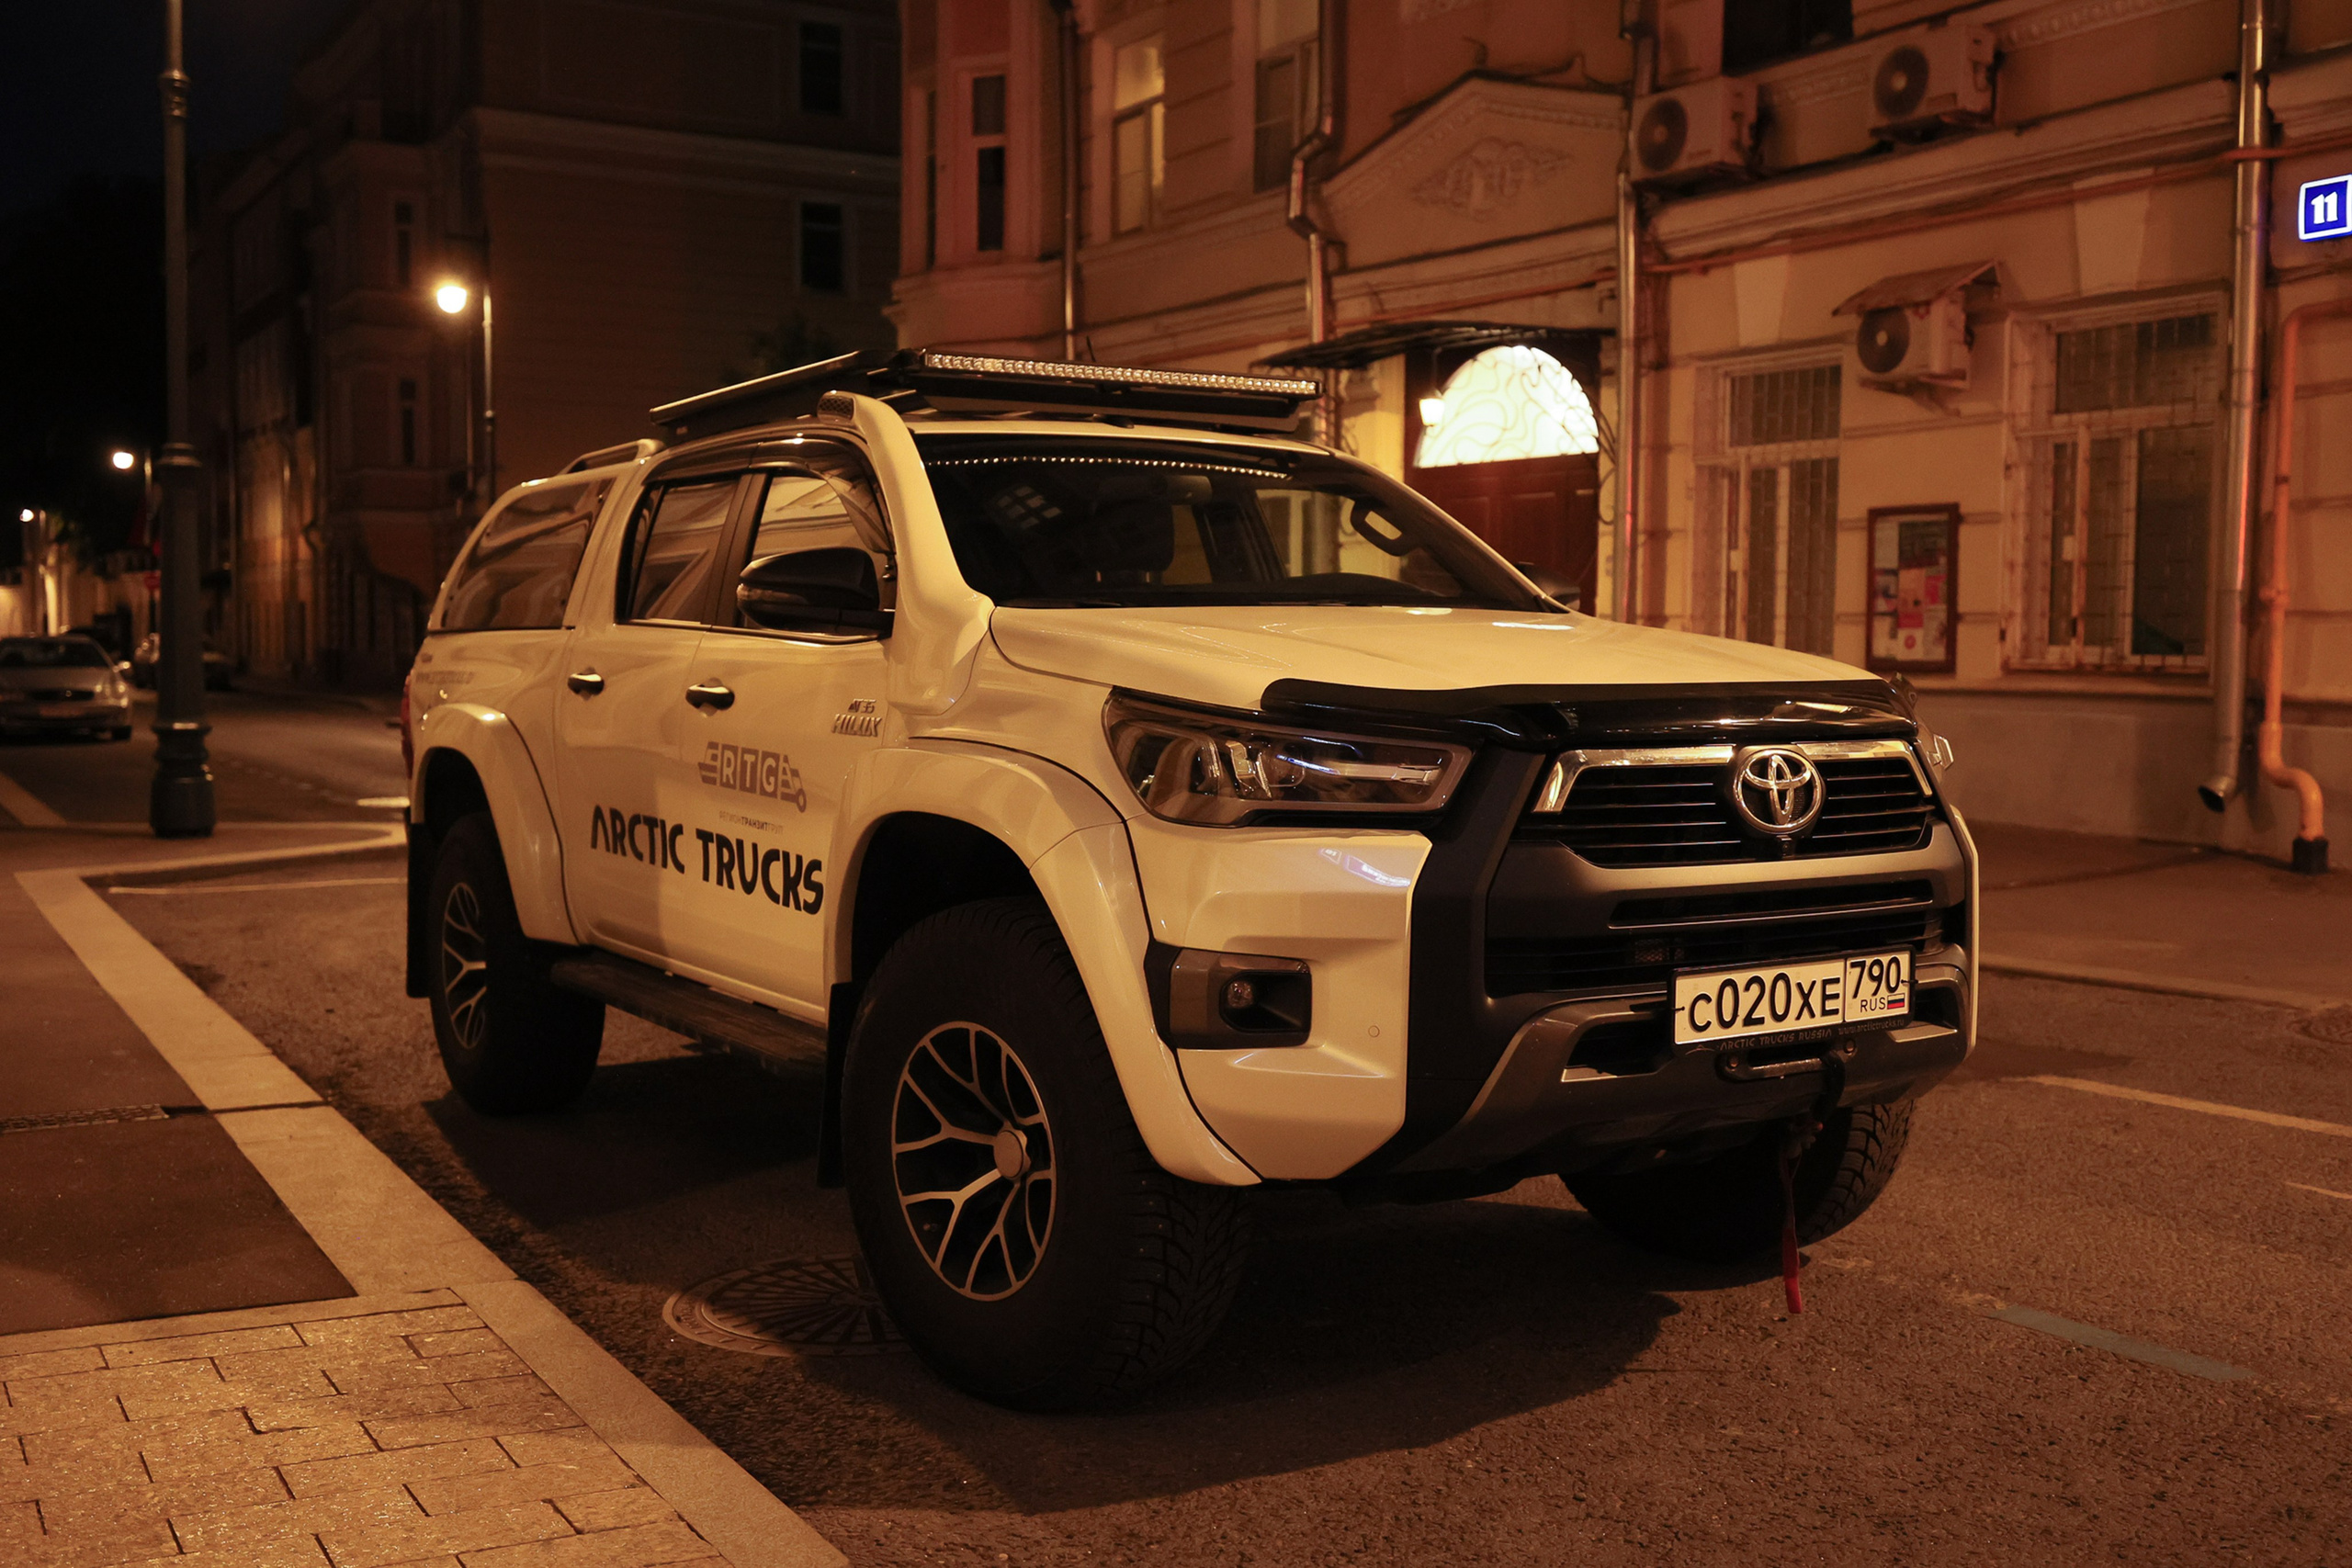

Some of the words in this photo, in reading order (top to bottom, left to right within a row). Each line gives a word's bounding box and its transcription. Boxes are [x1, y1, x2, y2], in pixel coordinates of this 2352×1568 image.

[2311, 191, 2338, 224] 11
[831, 713, 882, 738] HILUX
[591, 804, 685, 874] ARCTIC
[695, 828, 824, 915] TRUCKS
[1849, 956, 1902, 999] 790
[1860, 997, 1886, 1012] RUS
[1720, 1037, 1755, 1051] ARCTIC
[1759, 1032, 1795, 1045] TRUCKS
[1798, 1029, 1832, 1041] RUSSIA
